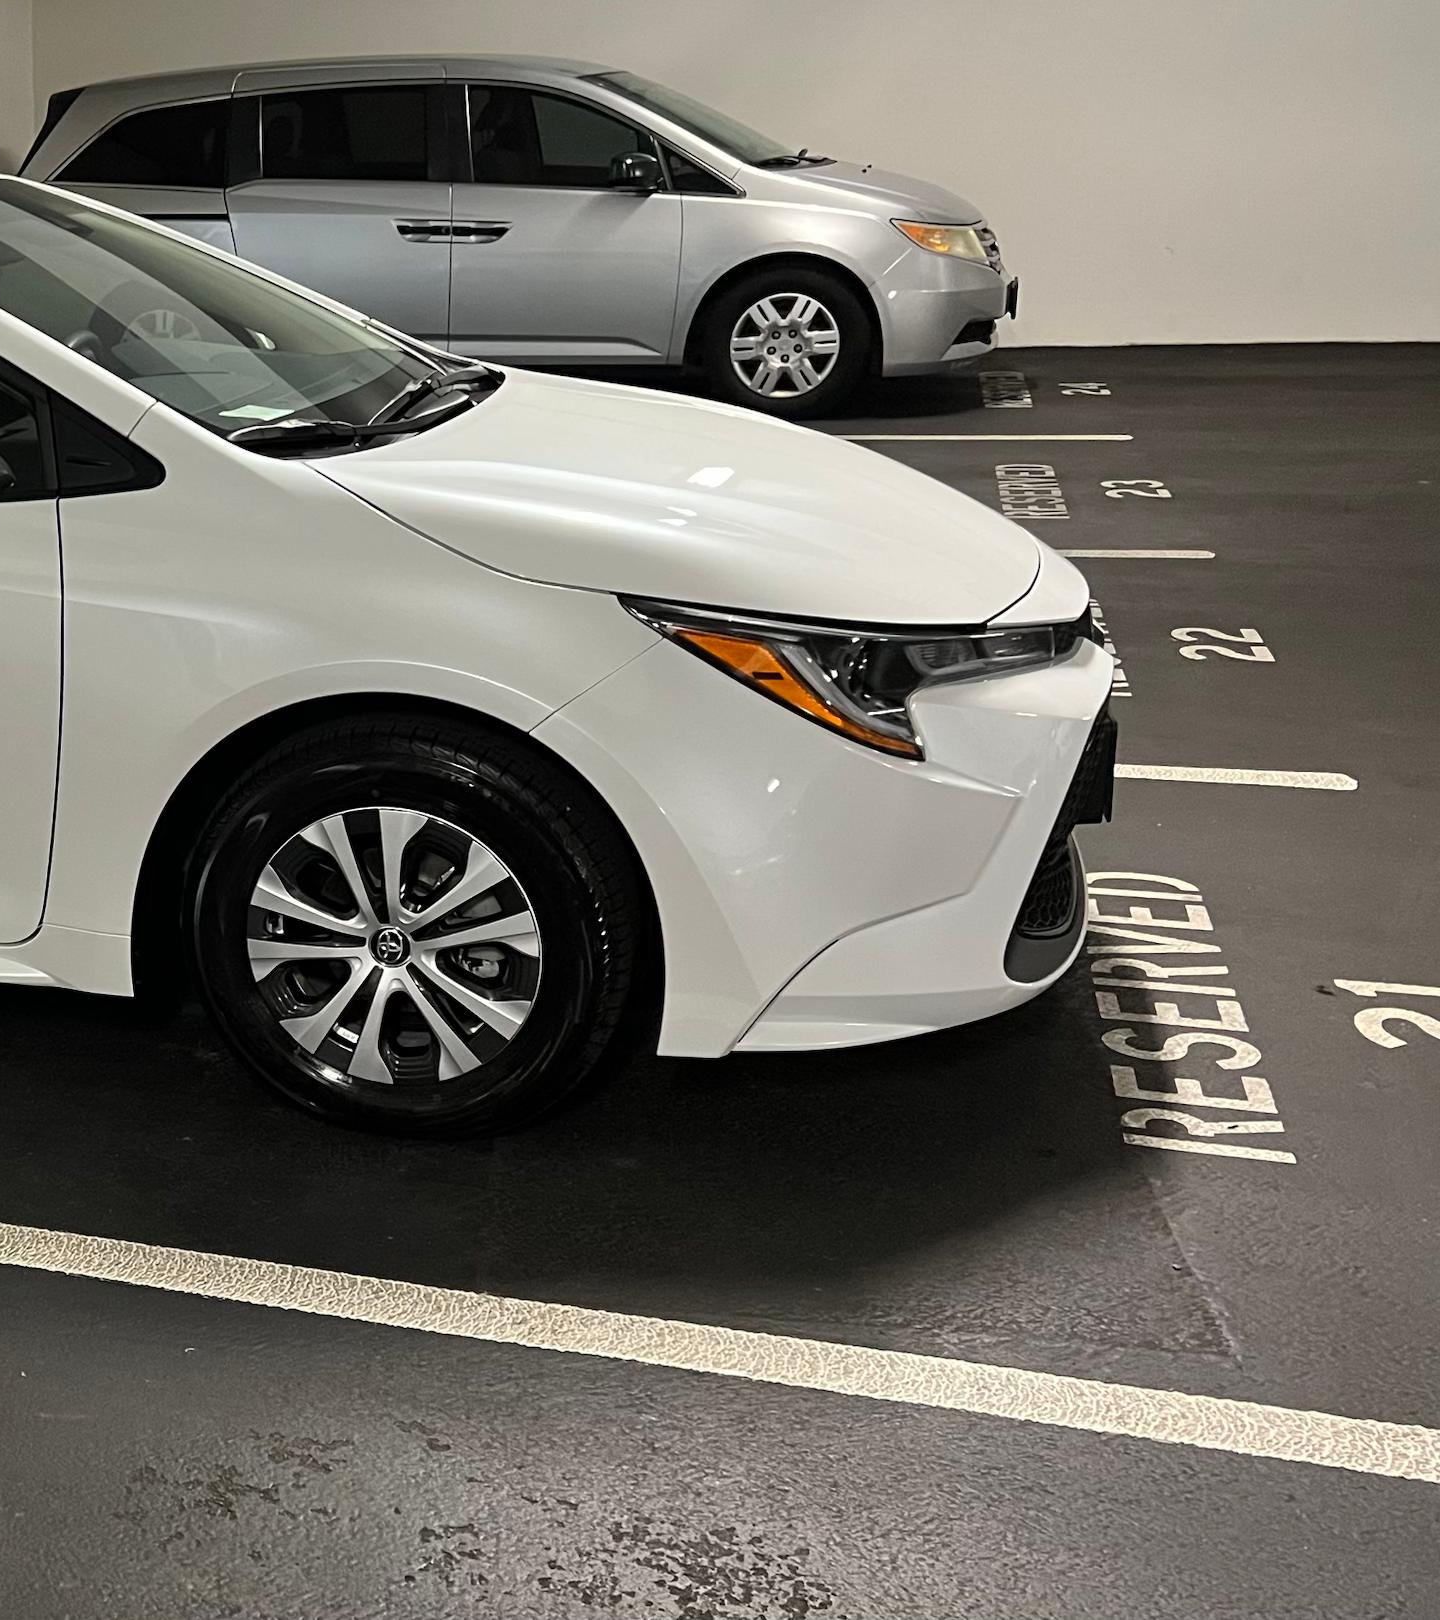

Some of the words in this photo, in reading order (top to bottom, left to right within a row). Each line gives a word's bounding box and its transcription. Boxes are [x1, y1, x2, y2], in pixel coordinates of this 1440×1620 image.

[1058, 382, 1111, 396] 24
[995, 464, 1070, 519] RESERVED
[1100, 480, 1172, 498] 23
[1170, 627, 1276, 663] 22
[1086, 871, 1298, 1165] RESERVED
